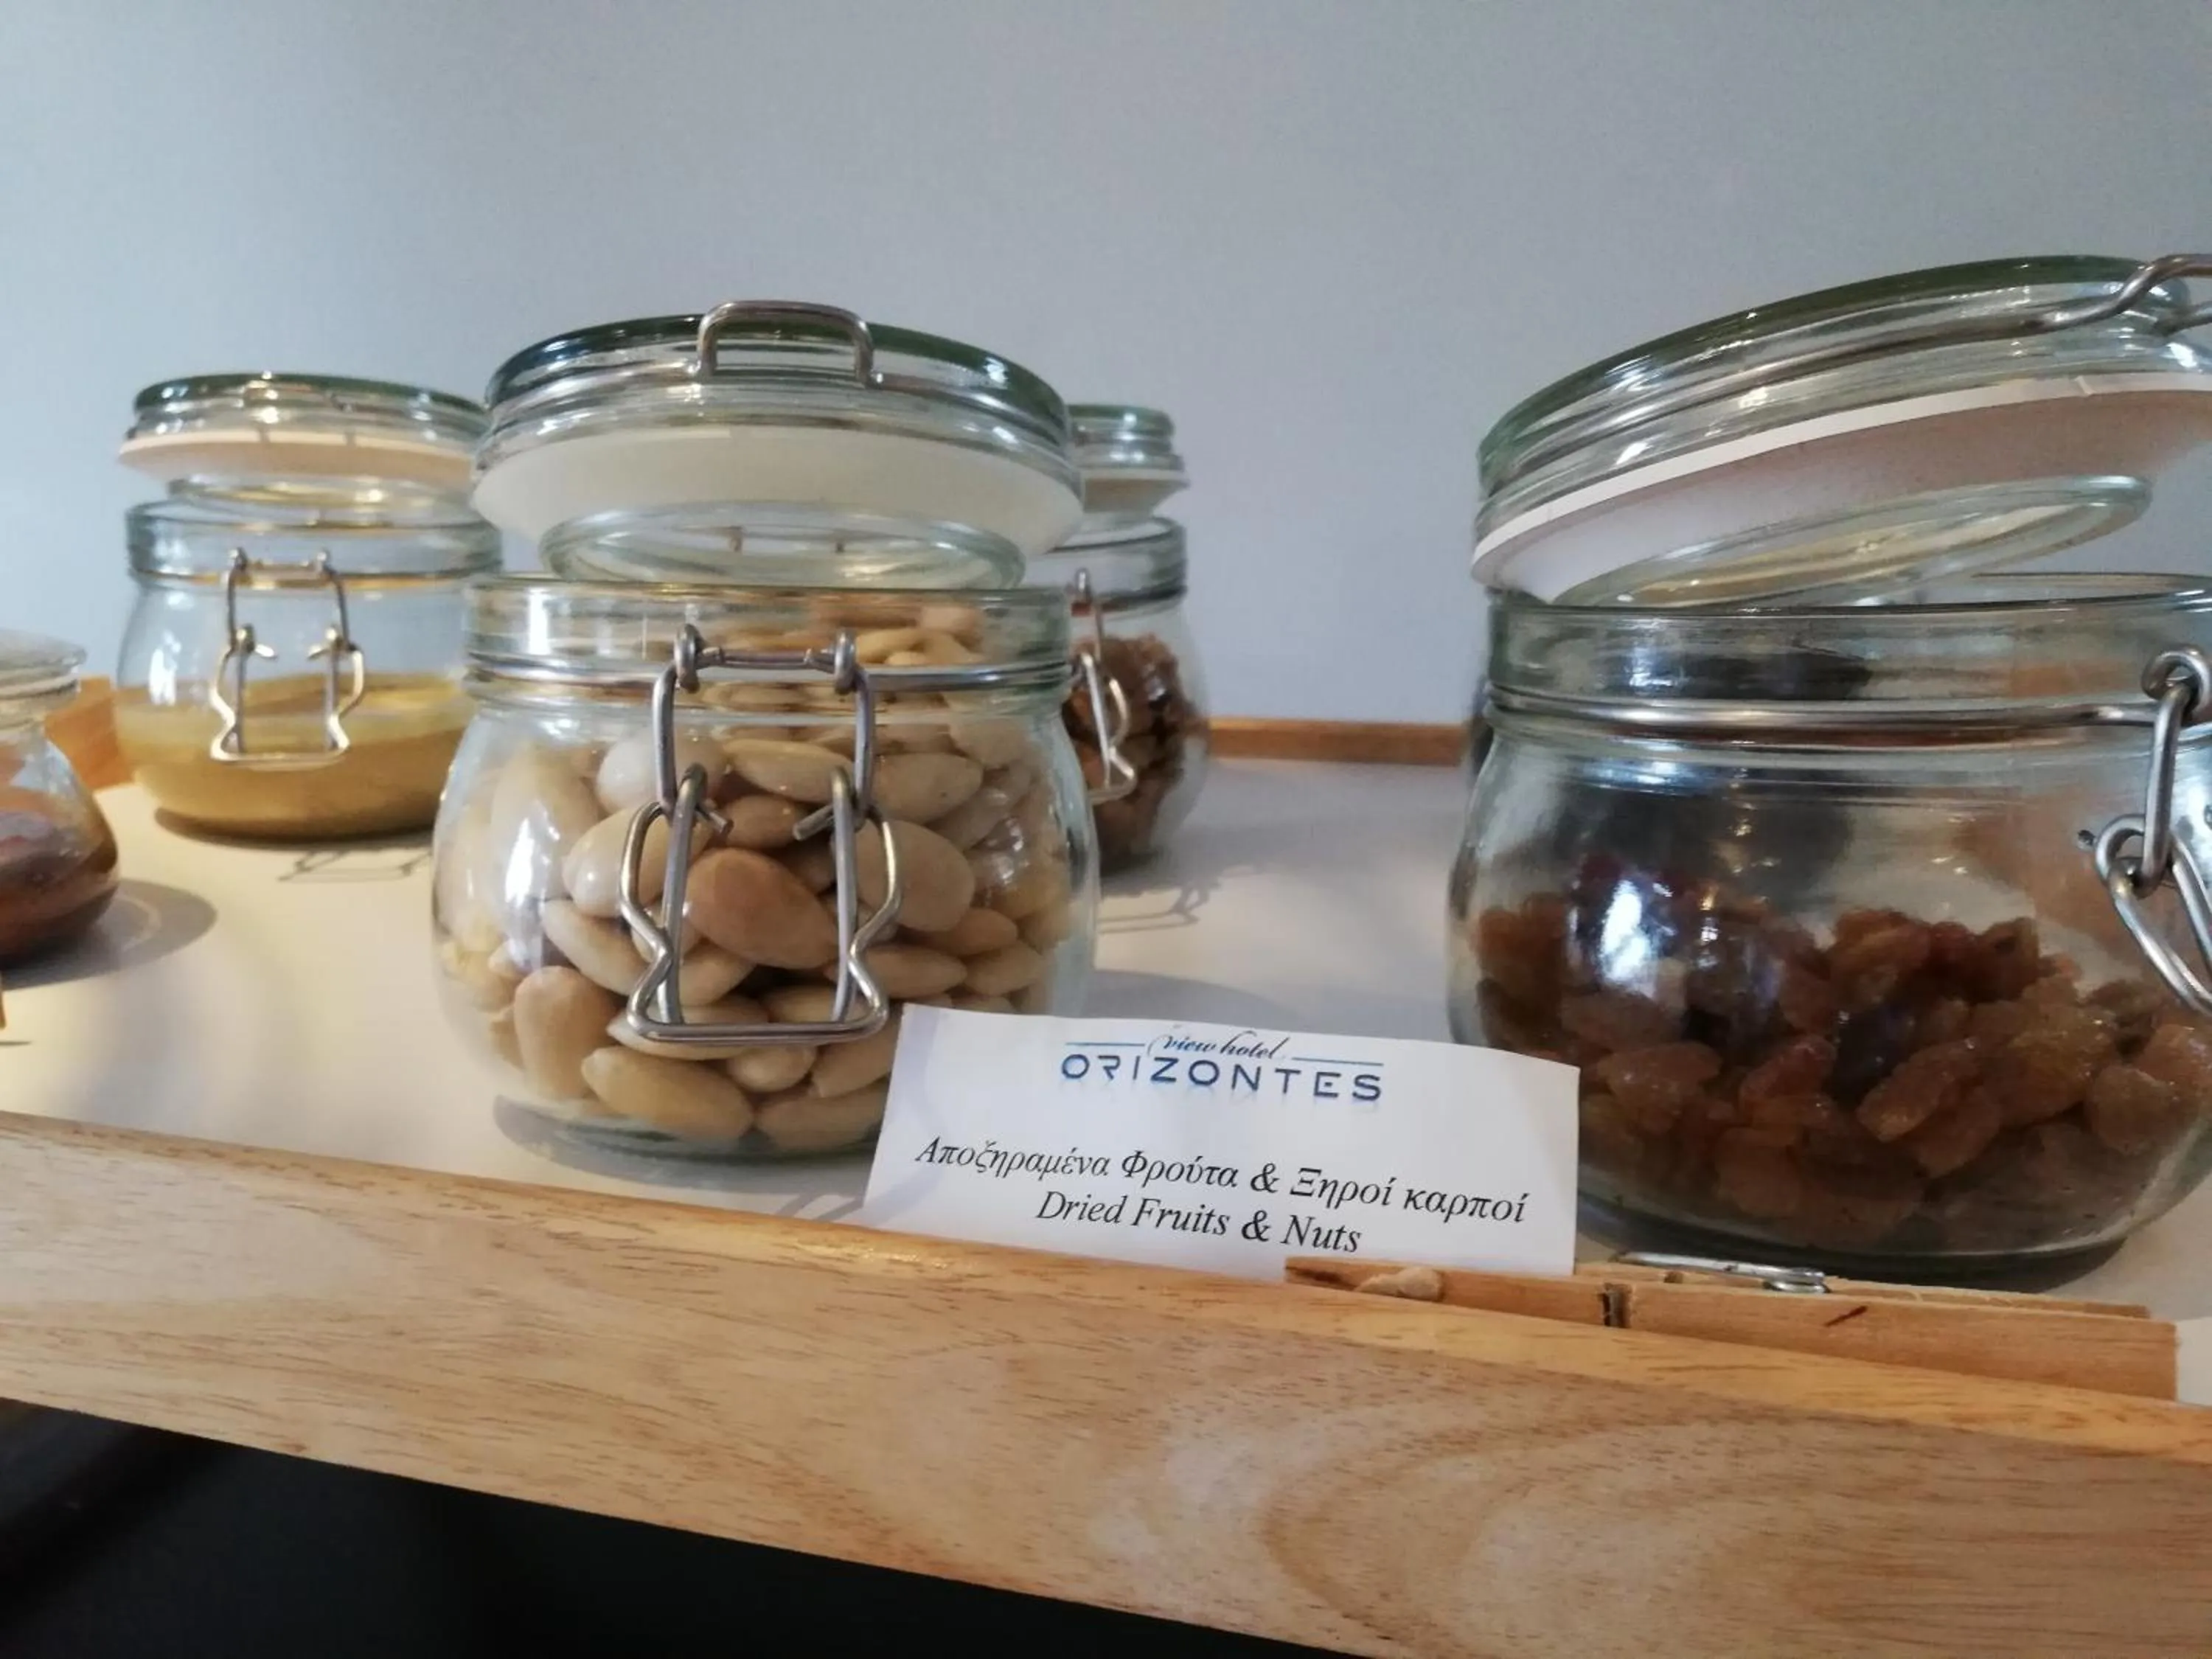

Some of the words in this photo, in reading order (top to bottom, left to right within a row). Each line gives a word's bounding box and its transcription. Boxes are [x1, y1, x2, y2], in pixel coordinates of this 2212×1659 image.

[1151, 1034, 1217, 1054] view
[1219, 1030, 1290, 1060] hotel
[1061, 1053, 1382, 1102] ORIZONTES
[915, 1135, 1110, 1180] Αποξηραμένα
[1121, 1150, 1239, 1188] Φρούτα
[1249, 1163, 1279, 1193] &
[1290, 1166, 1397, 1209] Ξηροί
[1402, 1187, 1530, 1223] καρποί
[1036, 1190, 1128, 1224] Dried
[1131, 1197, 1231, 1236] Fruits
[1241, 1209, 1270, 1242] &
[1280, 1214, 1363, 1253] Nuts
